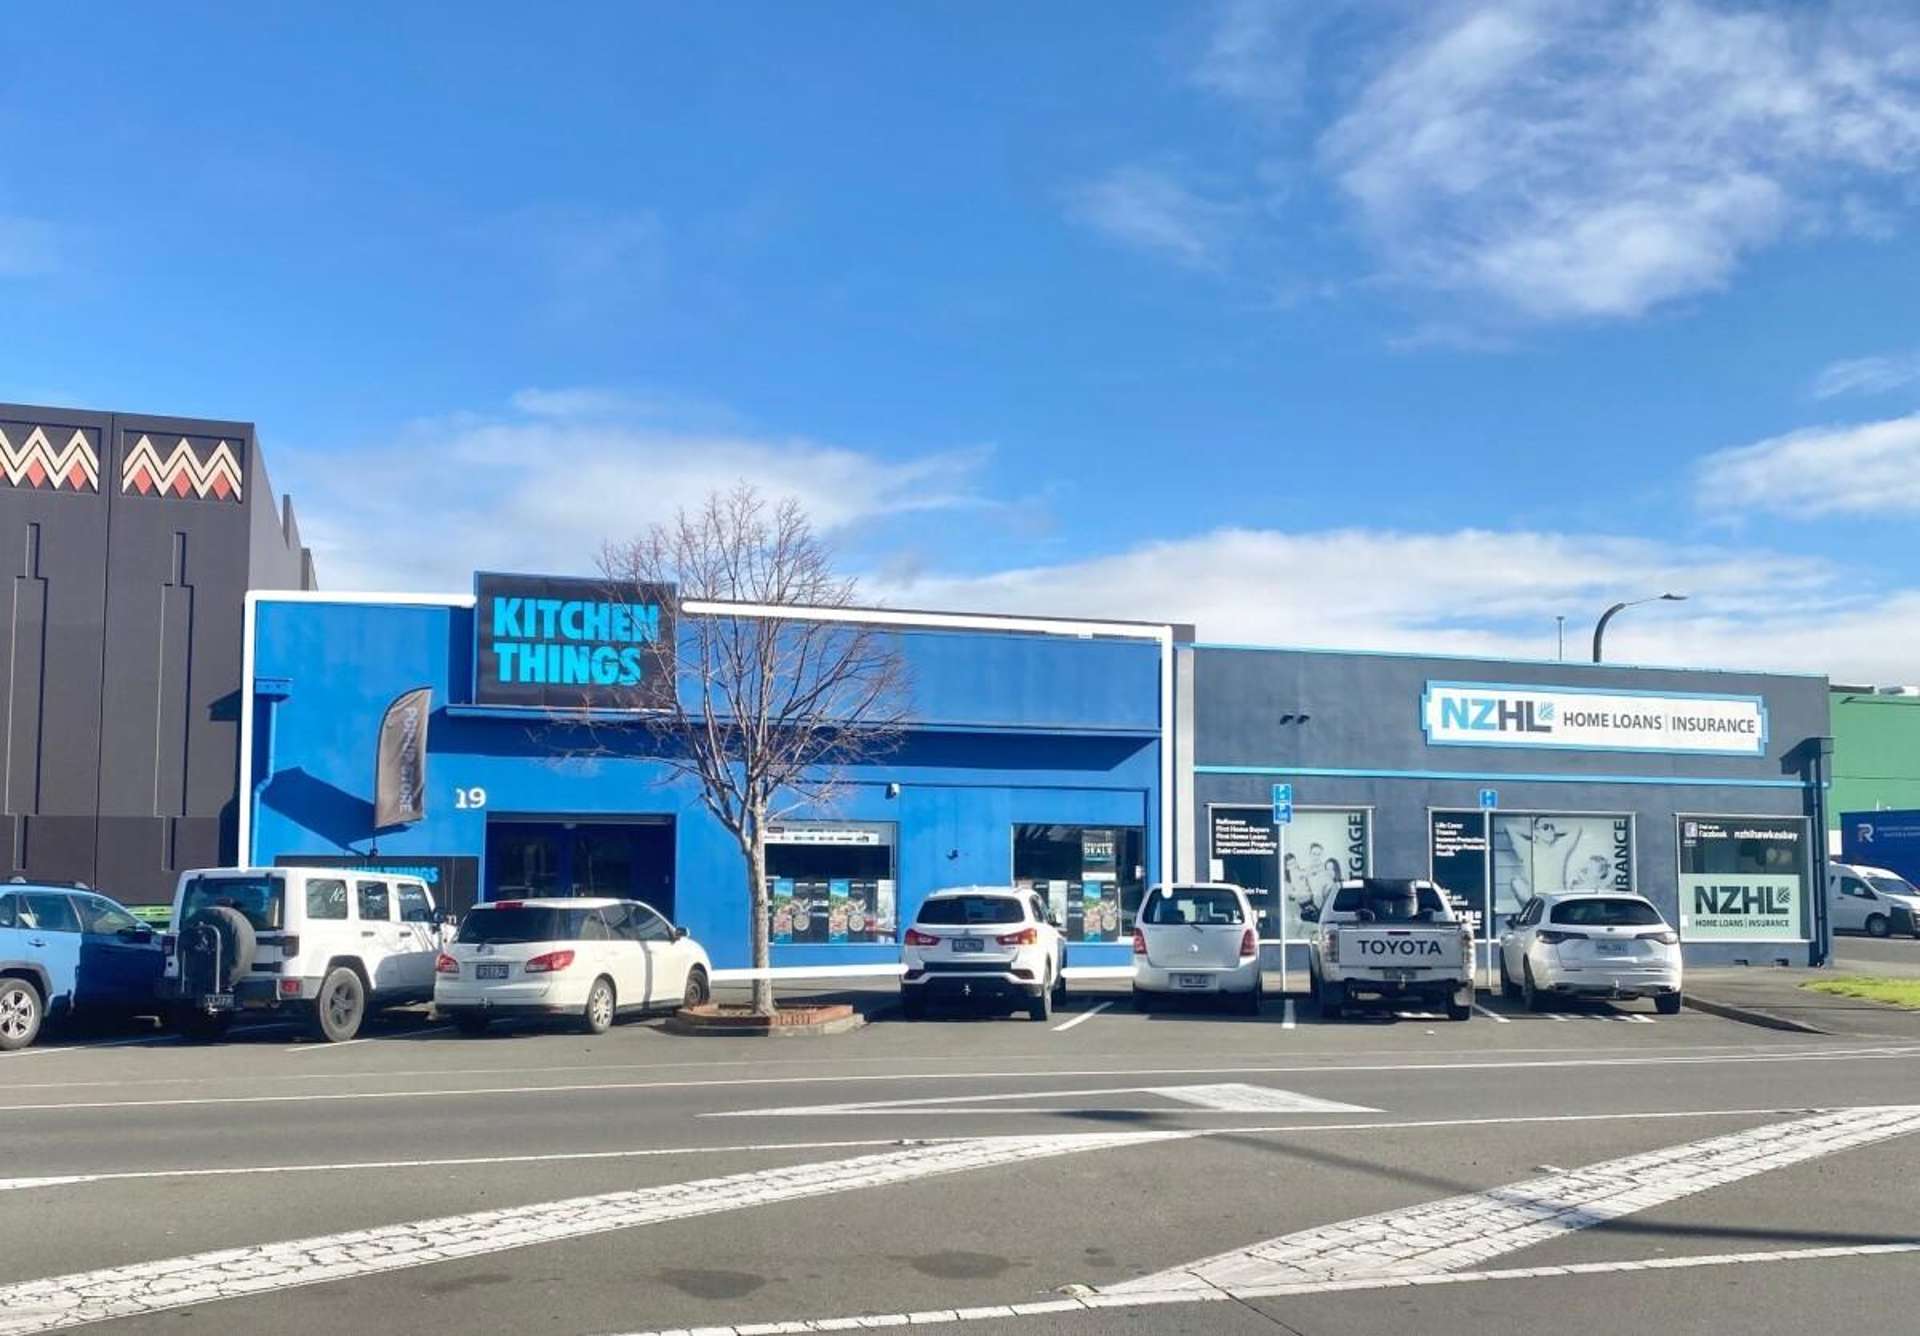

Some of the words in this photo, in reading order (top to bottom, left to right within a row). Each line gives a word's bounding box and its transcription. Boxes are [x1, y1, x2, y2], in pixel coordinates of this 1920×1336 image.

[494, 597, 660, 642] KITCHEN
[494, 642, 641, 686] THINGS
[1441, 697, 1552, 733] NZHL
[1563, 712, 1609, 727] HOME
[1613, 713, 1662, 730] LOANS
[1672, 716, 1755, 734] INSURANCE
[455, 787, 486, 809] 19
[1349, 812, 1364, 879] TGAGE
[1614, 819, 1630, 891] RANCE
[1694, 886, 1789, 914] NZHL
[1695, 919, 1718, 927] HOME
[1720, 919, 1744, 927] LOANS
[1748, 919, 1789, 927] INSURANCE
[1357, 940, 1442, 955] TOYOTA
